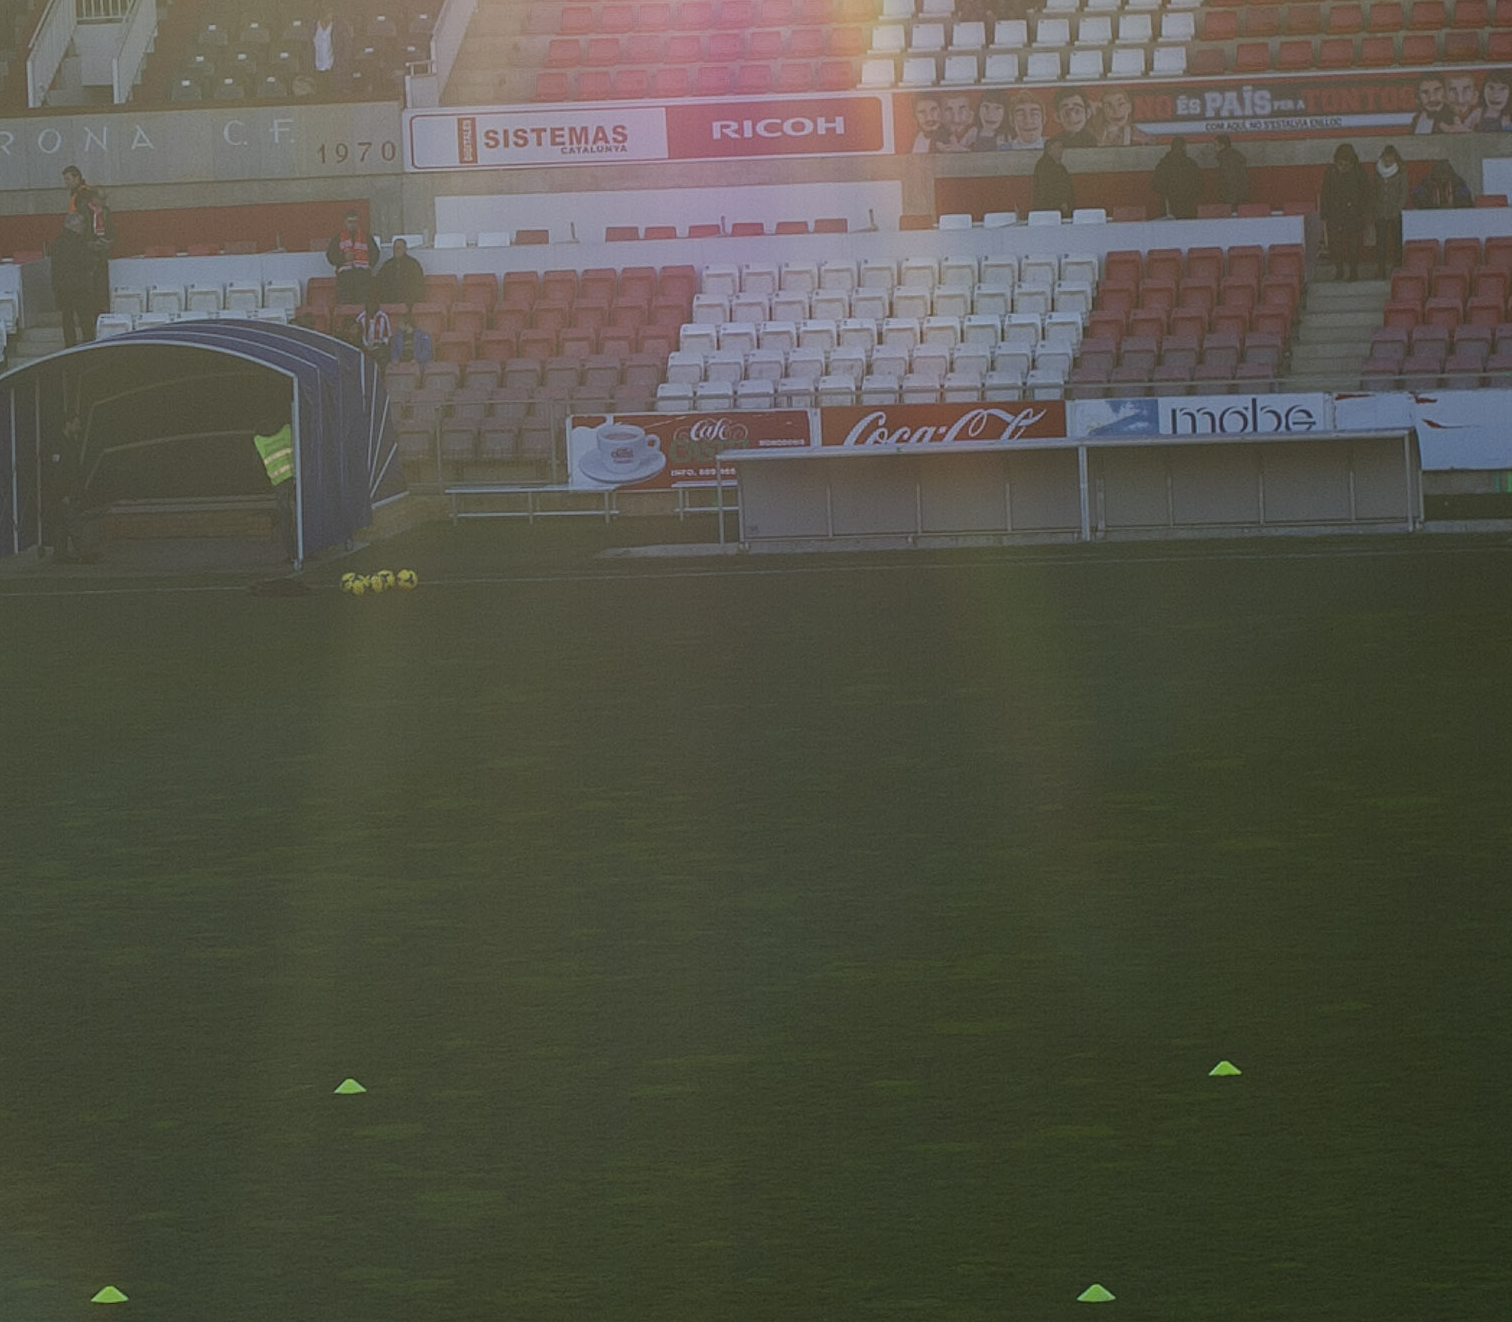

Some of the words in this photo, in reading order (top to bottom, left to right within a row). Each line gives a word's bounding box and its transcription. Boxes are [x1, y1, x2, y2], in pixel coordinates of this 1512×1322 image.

[1133, 94, 1172, 119] NO
[1302, 85, 1417, 114] TONTOS
[483, 125, 629, 149] SISTEMAS
[711, 116, 845, 140] RICOH
[318, 139, 397, 164] 1970
[560, 144, 628, 155] CATALUNYA
